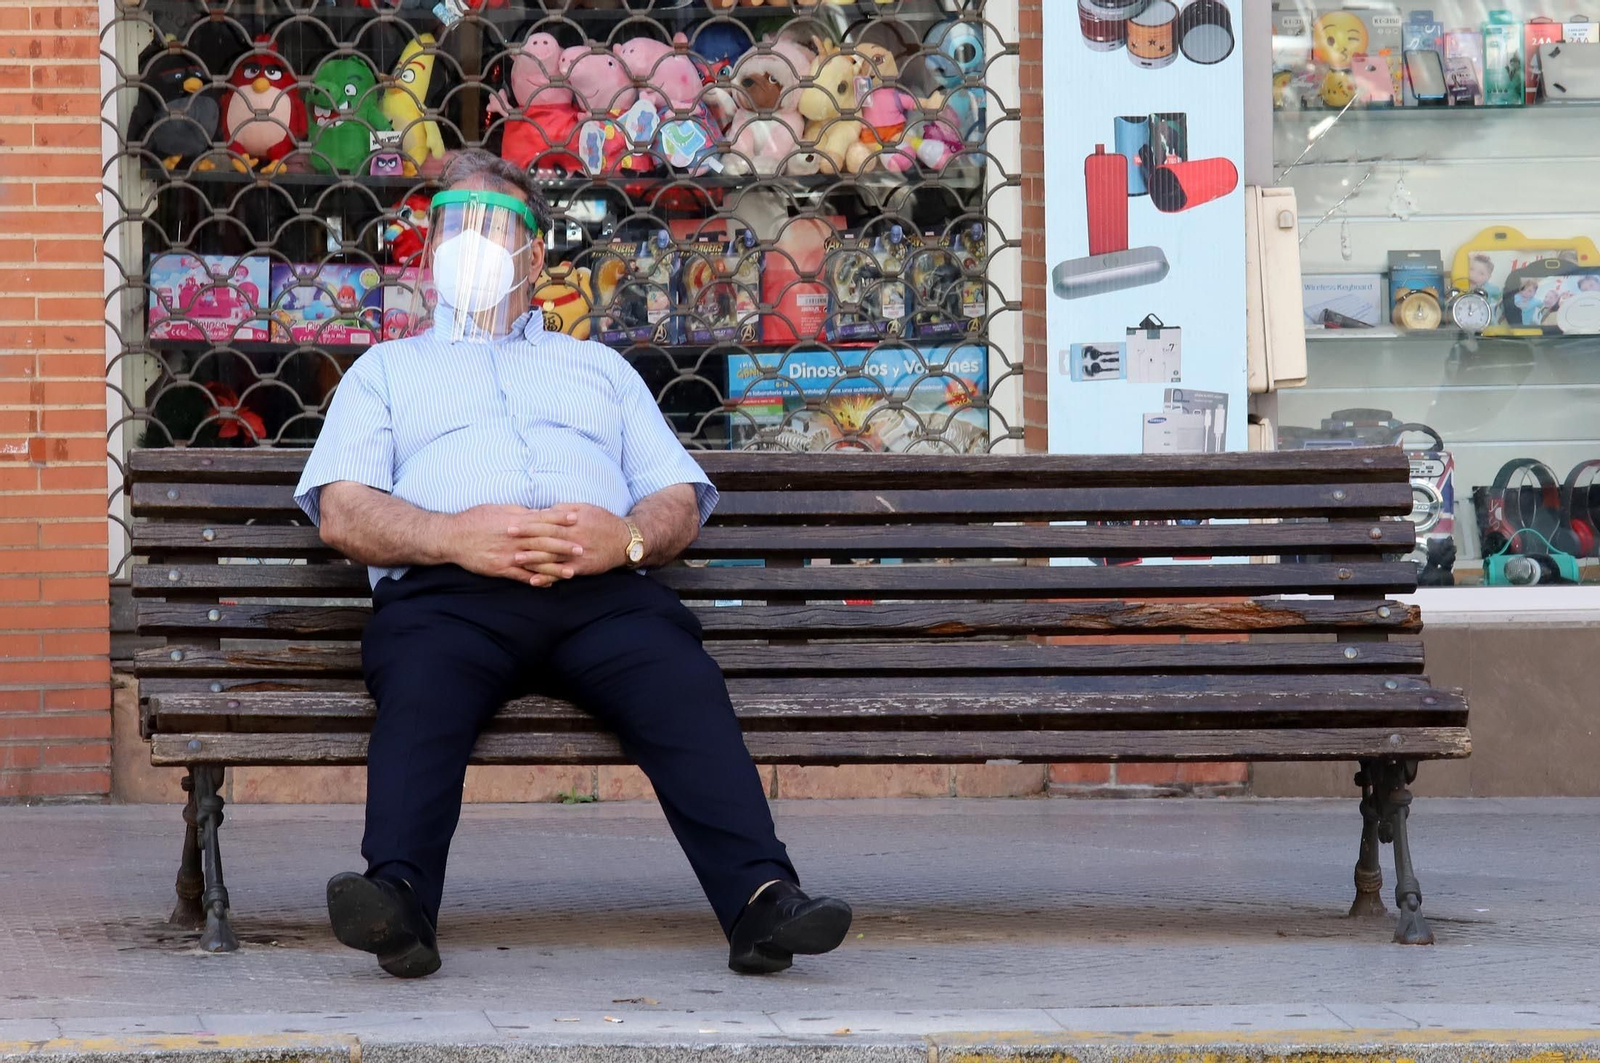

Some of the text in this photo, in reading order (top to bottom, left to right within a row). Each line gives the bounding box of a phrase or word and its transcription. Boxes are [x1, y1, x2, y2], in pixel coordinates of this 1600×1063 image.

[1336, 284, 1373, 292] Keyboard
[789, 361, 888, 379] Dinosaios
[892, 366, 899, 377] y
